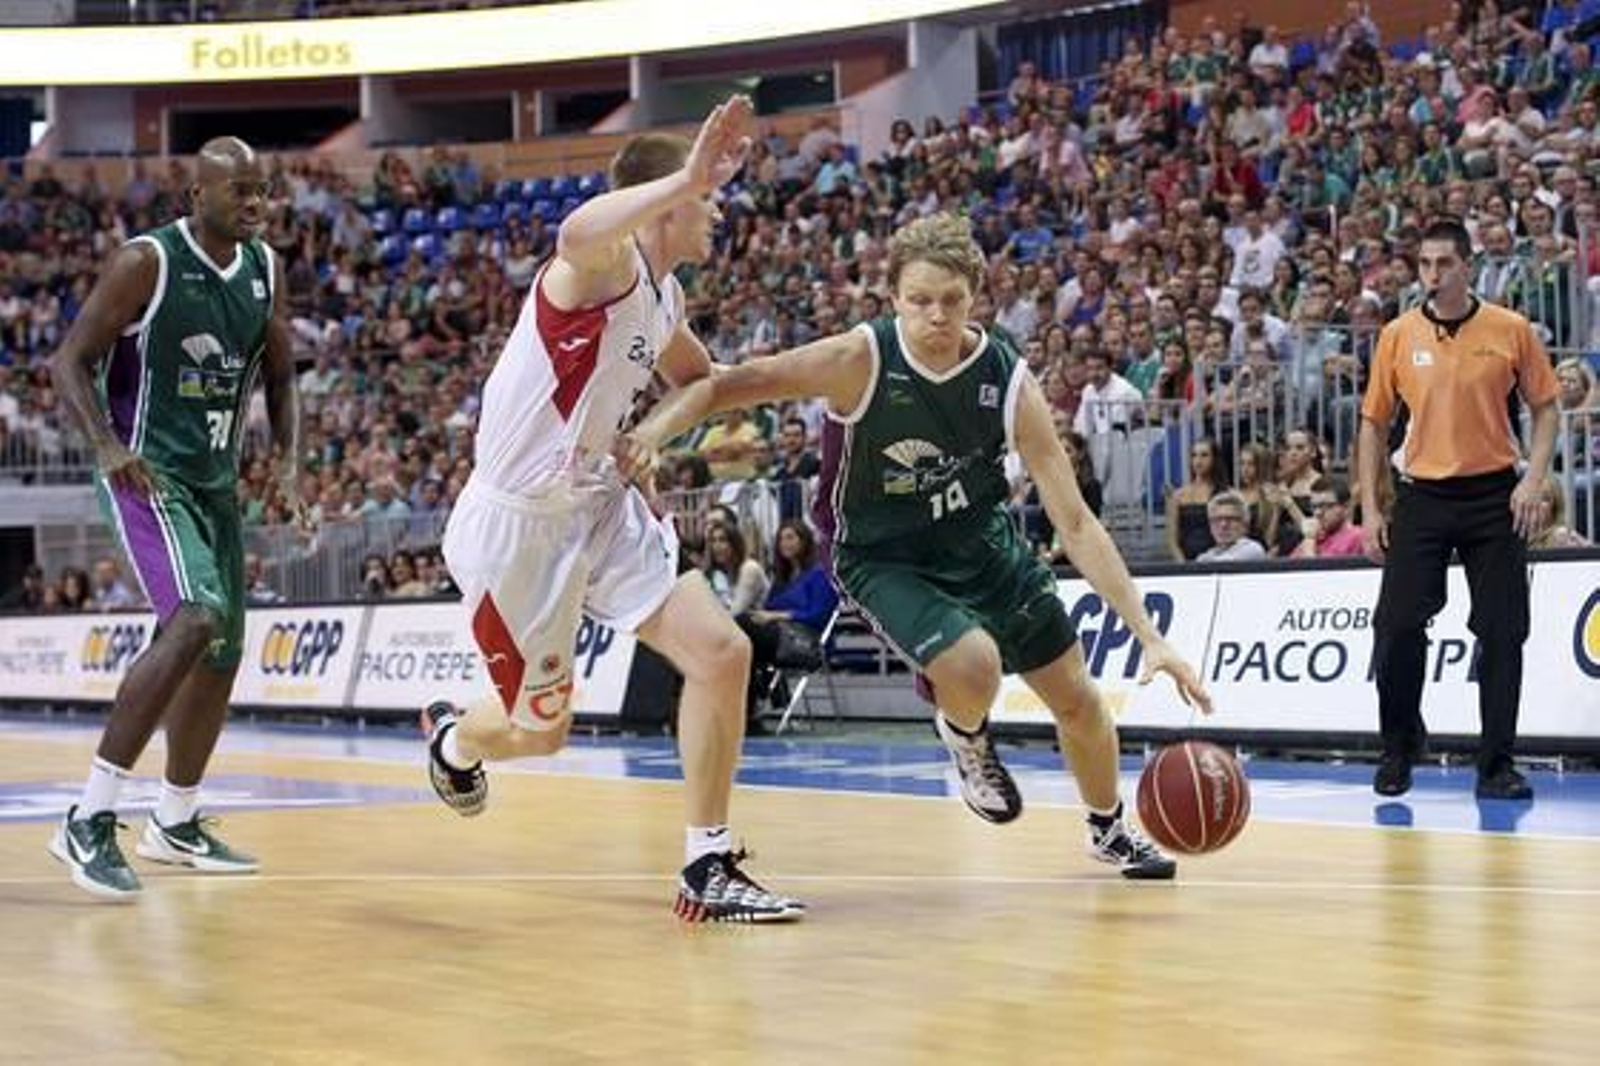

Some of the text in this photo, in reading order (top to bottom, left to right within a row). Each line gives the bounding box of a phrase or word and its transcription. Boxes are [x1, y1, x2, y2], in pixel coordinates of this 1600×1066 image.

[192, 33, 352, 69] Folletos
[360, 652, 478, 681] PACO PEPE
[1212, 640, 1348, 682] PACO
